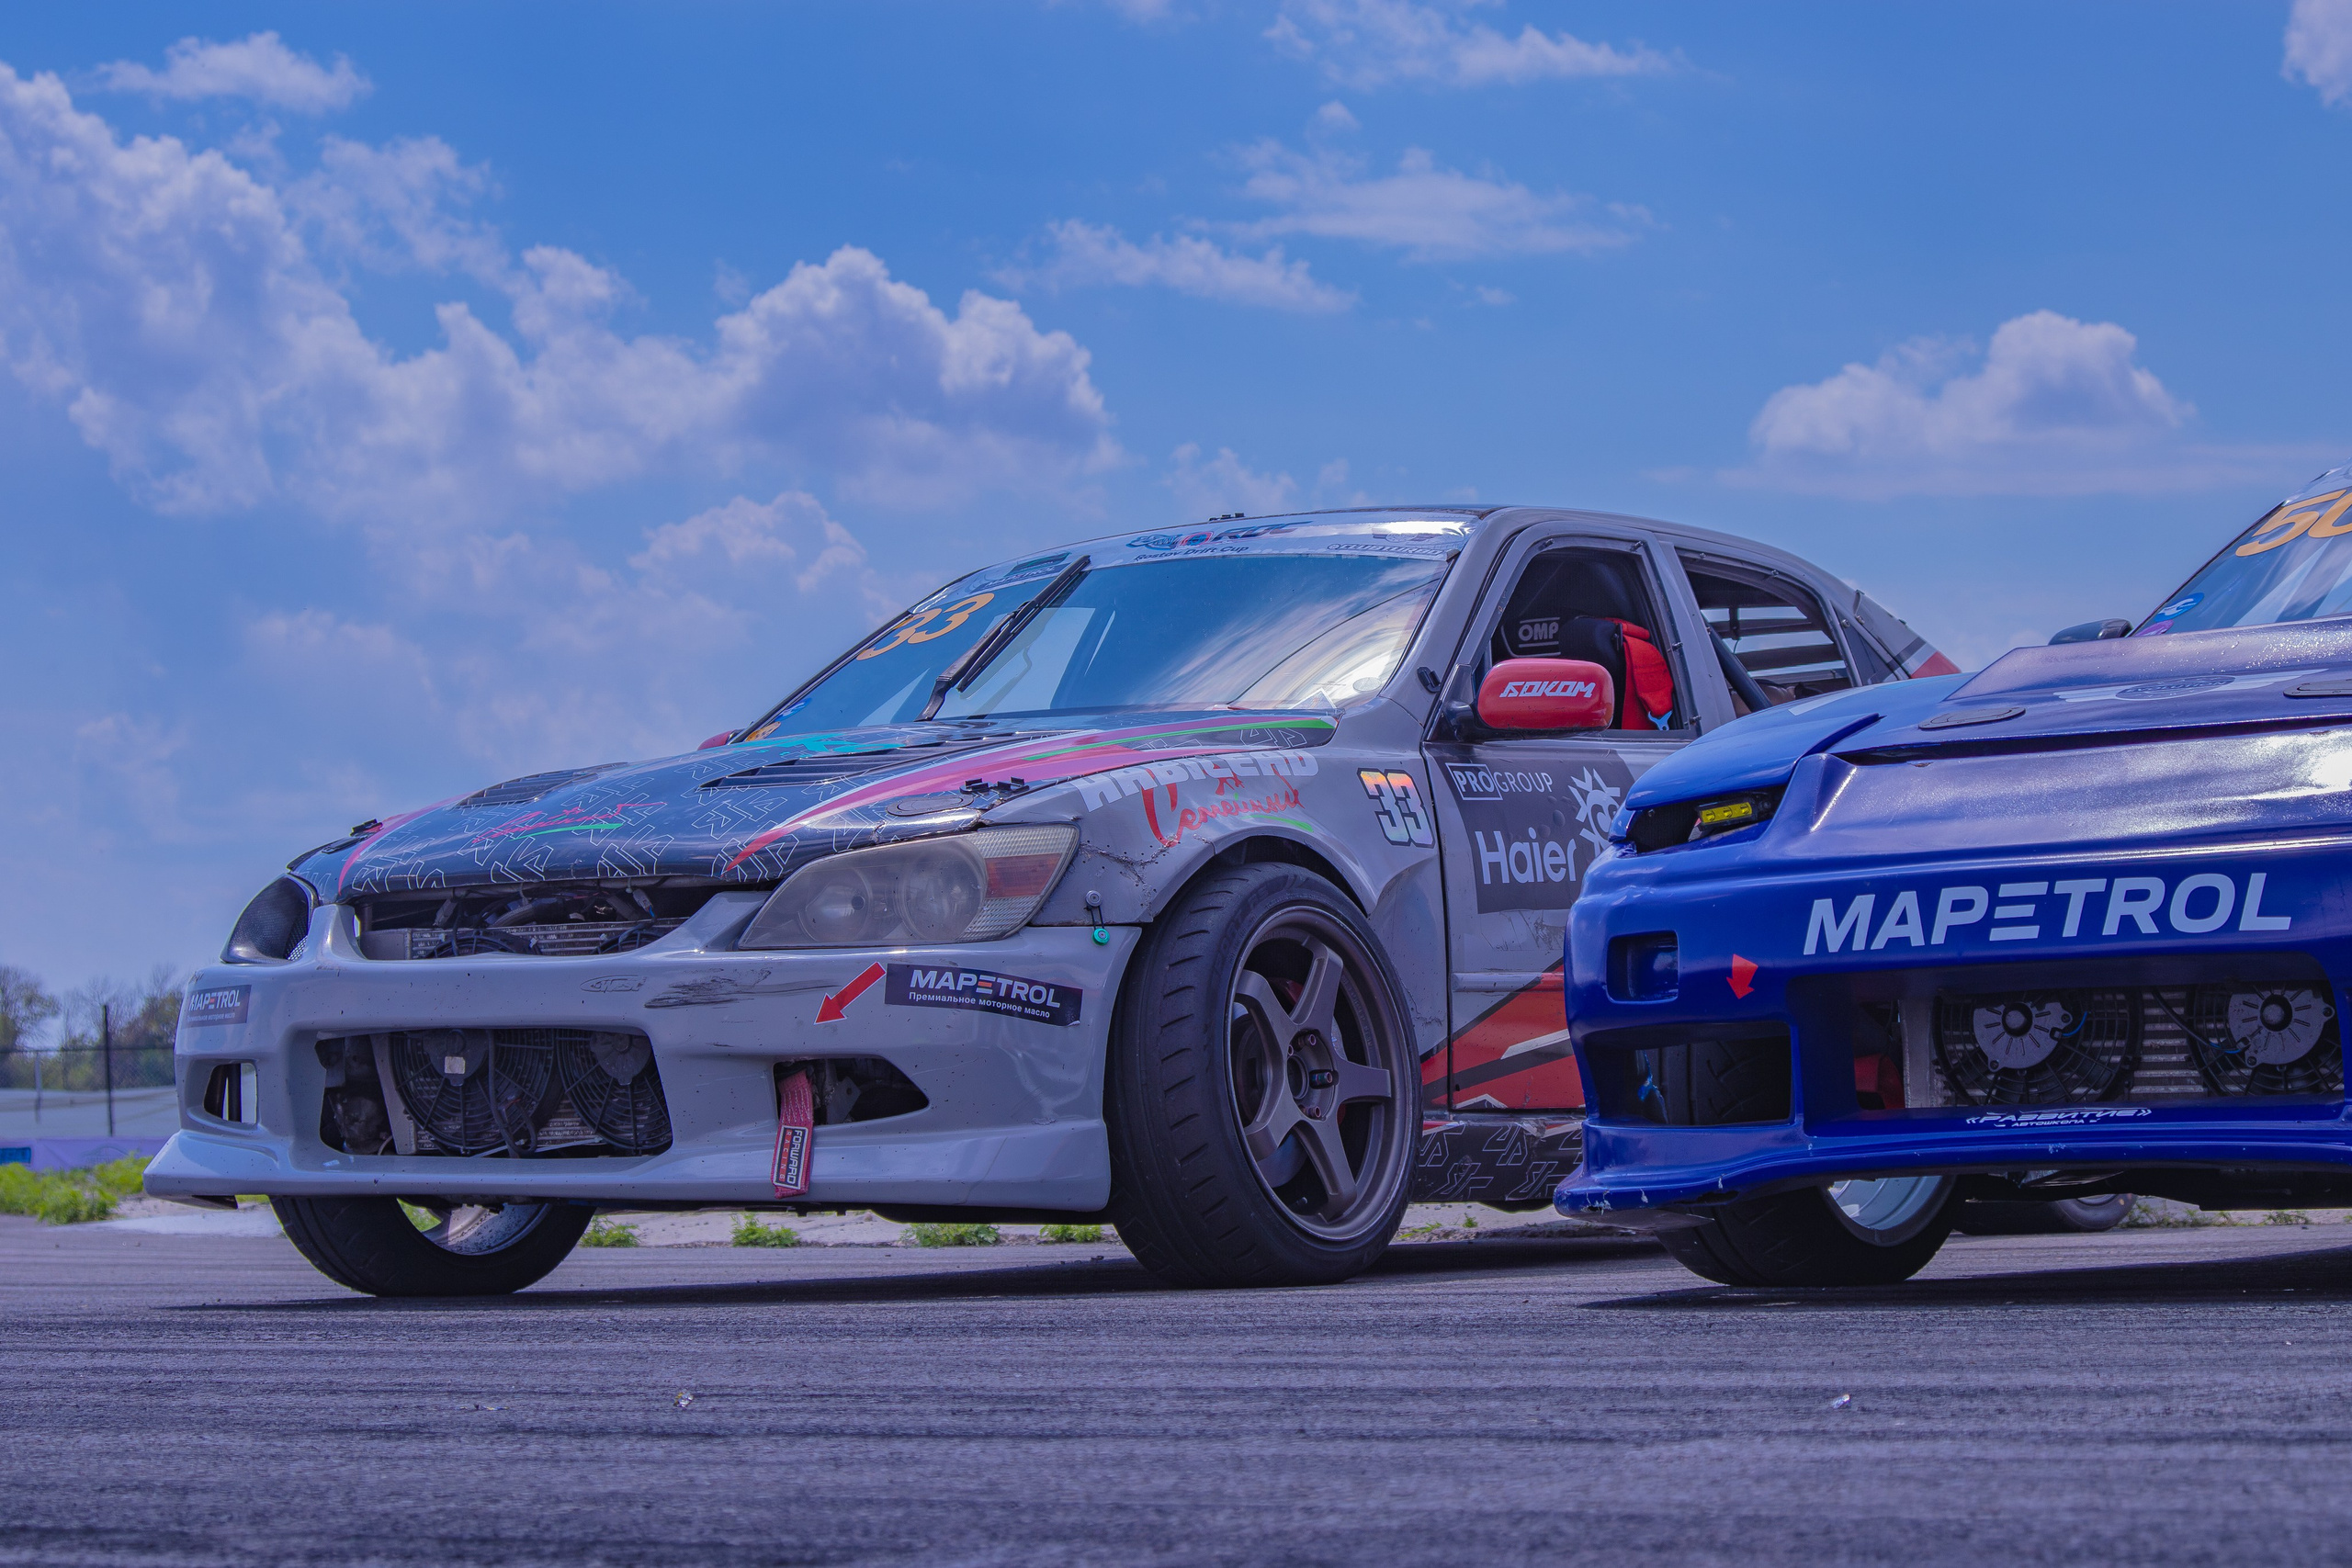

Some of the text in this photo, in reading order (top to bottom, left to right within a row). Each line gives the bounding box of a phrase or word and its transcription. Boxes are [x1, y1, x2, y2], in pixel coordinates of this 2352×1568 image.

[1134, 550, 1180, 562] Rostov
[1182, 546, 1218, 556] Drift
[856, 592, 995, 660] 33
[1518, 621, 1559, 641] OMP
[1357, 768, 1434, 848] 33
[1475, 830, 1577, 886] Haier
[1804, 872, 2292, 956] MAPETROL
[188, 989, 241, 1011] MAPETROL
[909, 991, 1051, 1019] Премиальное моторное масло
[910, 969, 1061, 1009] MAPETROL
[2011, 1118, 2085, 1128] АВТОШКОЛА
[779, 1131, 792, 1179] RACING
[786, 1129, 803, 1185] FORWARD
